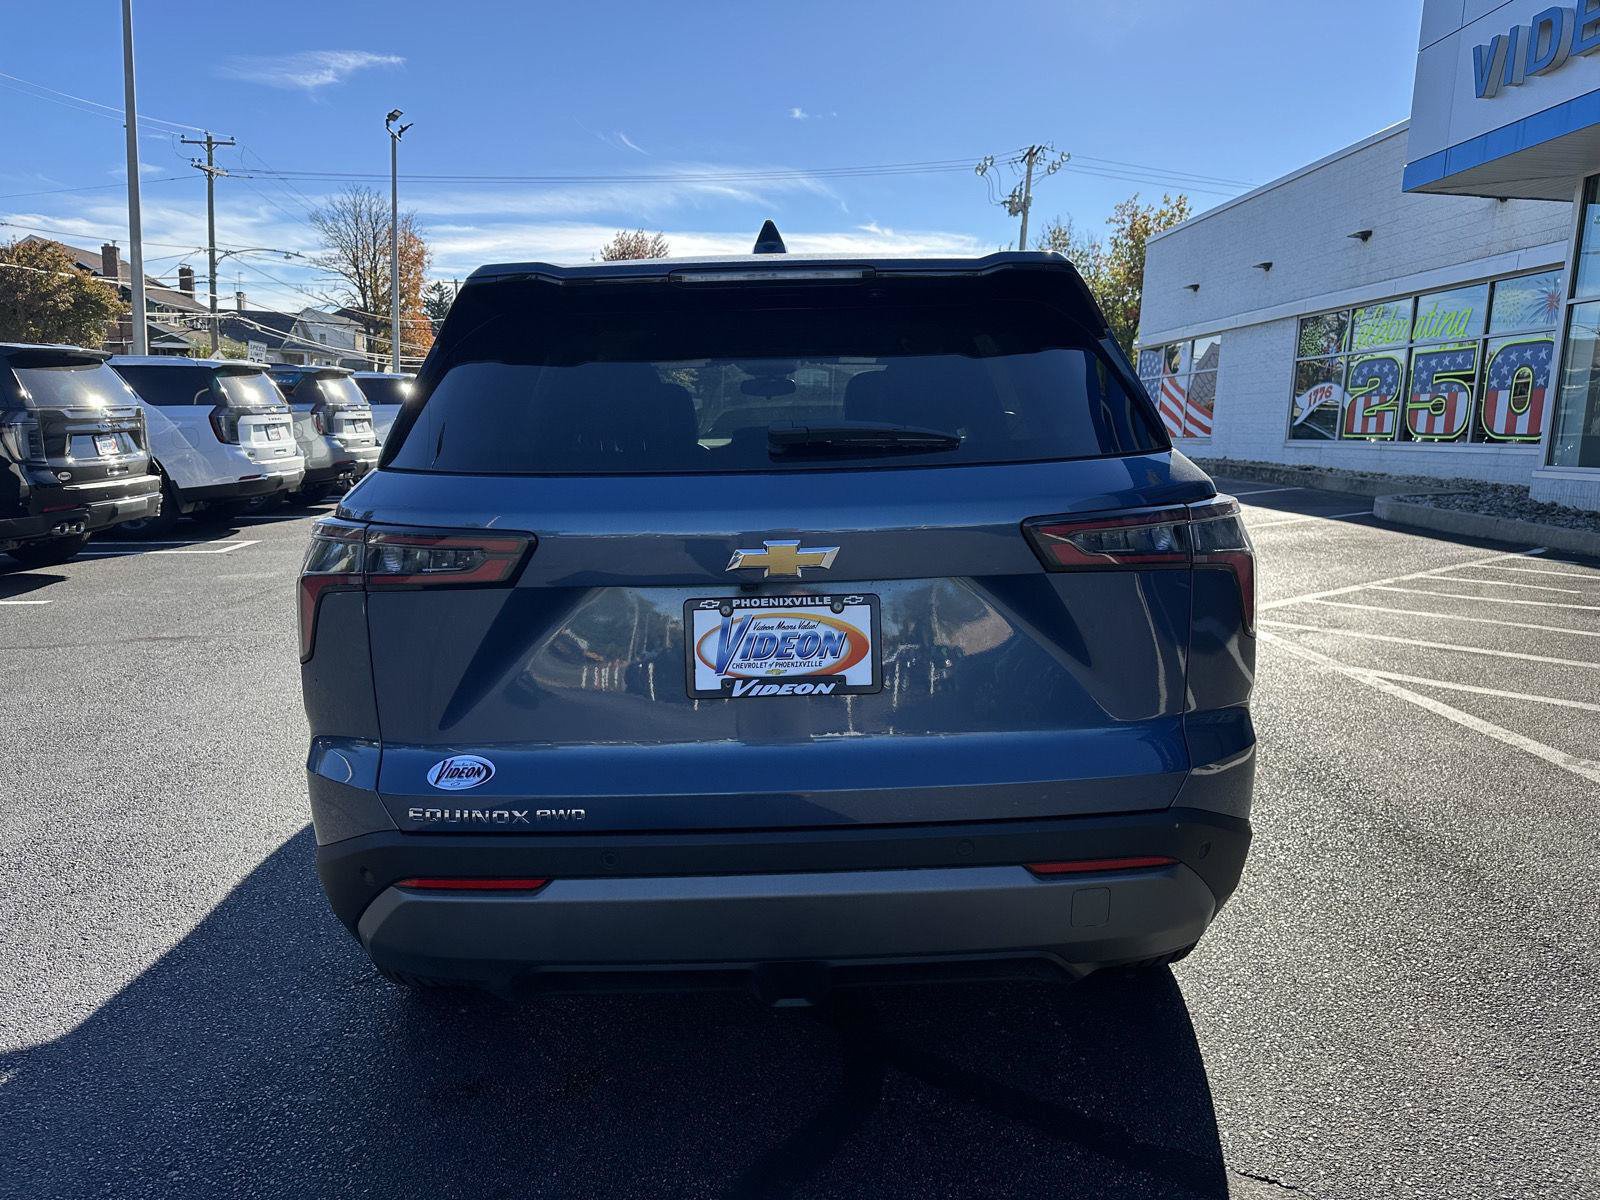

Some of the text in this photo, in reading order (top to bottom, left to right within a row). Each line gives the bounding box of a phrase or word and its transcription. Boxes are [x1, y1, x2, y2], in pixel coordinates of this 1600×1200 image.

[250, 344, 265, 352] SPEED
[1308, 384, 1334, 407] 1776
[1343, 337, 1554, 442] 250
[732, 596, 832, 608] PHOENIXVILLE
[715, 614, 848, 676] VIDEON
[732, 661, 767, 669] CHEVROLET
[775, 660, 823, 668] PHOENIXVILLE
[732, 679, 836, 697] VIDEON
[434, 759, 485, 785] VIDEON
[408, 807, 586, 824] EQUINOX AWD
